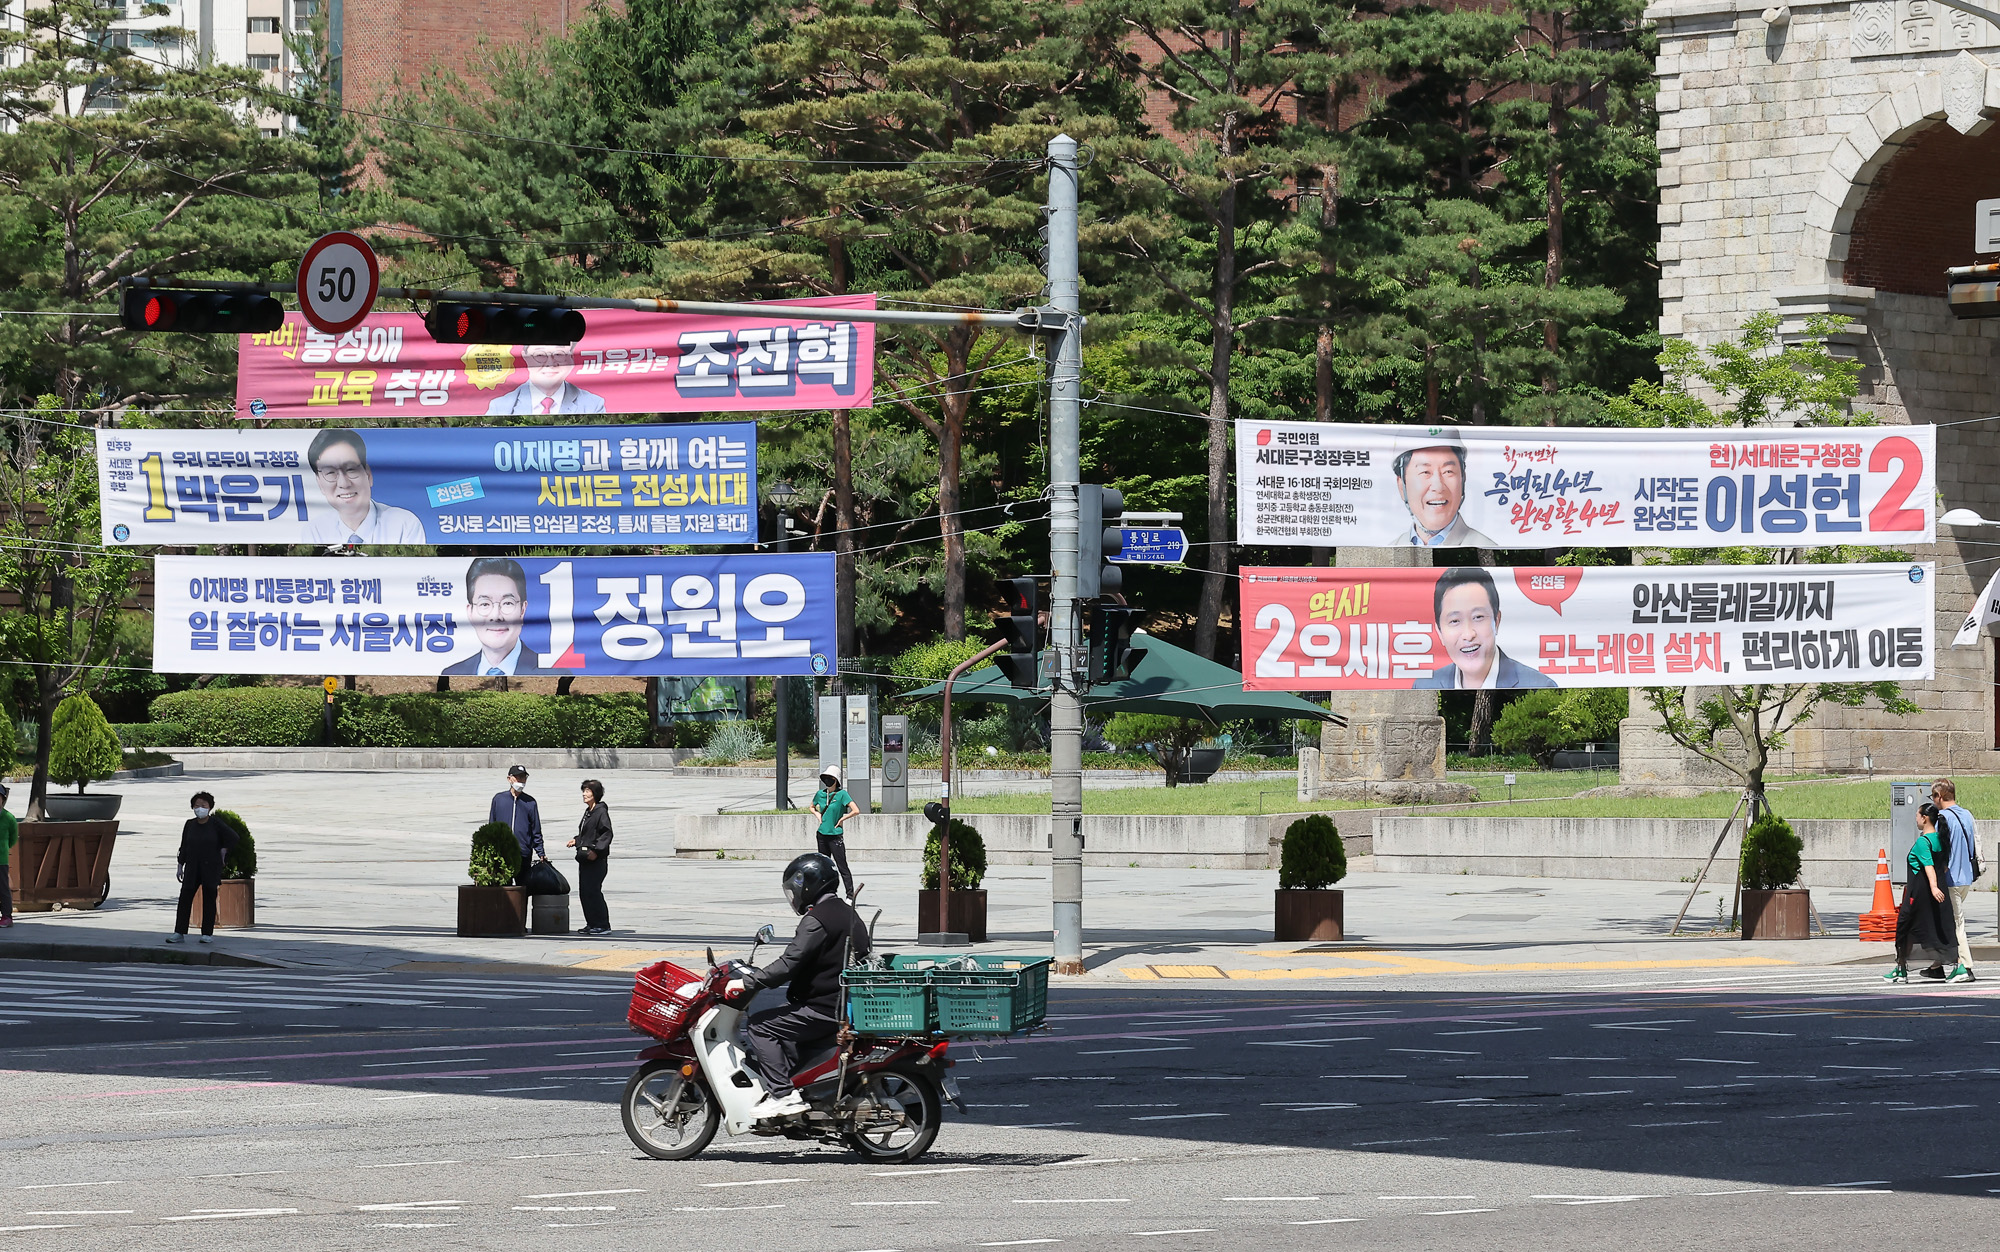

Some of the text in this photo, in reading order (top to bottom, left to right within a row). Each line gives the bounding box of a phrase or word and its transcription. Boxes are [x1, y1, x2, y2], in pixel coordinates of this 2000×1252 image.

[318, 266, 356, 303] 50
[301, 326, 403, 363] 동성애
[576, 322, 857, 397] 교육감은 조전혁
[307, 369, 456, 407] 교육 추방
[106, 440, 132, 452] 민주당
[1277, 432, 1320, 446] 국민의힘
[108, 458, 133, 469] 서대문
[172, 450, 300, 469] 우리 모두의 구청장
[494, 435, 748, 473] 이재명과 함께 여는
[1256, 449, 1371, 467] 서대문구청장후보
[1709, 443, 1863, 470] 현)서대문구청장
[109, 470, 134, 481] 구청장
[110, 481, 127, 492] 후보
[138, 451, 176, 523] 1
[1256, 476, 1373, 491] 서대문 16·18대 국회의원(전)
[1484, 468, 1602, 506] 증명된 4년
[1868, 435, 1925, 532] 2
[175, 474, 309, 523] 박운기
[436, 482, 475, 503] 천연동
[537, 472, 748, 508] 서대문 전성시대
[1256, 491, 1291, 501] 연세대학교
[1634, 477, 1699, 503] 시작도
[1705, 473, 1862, 534] 이성헌
[1256, 514, 1358, 526] 성균관대학교 대학원 언론학 박사
[1308, 503, 1354, 514] 총동문회장(전)
[1511, 497, 1625, 535] 완성할 4년
[1633, 506, 1698, 532] 완성도
[438, 513, 748, 535] 경사로 스마트 안심길 조성, 틈새 돌봄 지원 확대
[1129, 531, 1161, 544] 통일로
[1256, 526, 1333, 537] 한국애견협회 부회장(현)
[1167, 541, 1180, 550] 219
[189, 577, 382, 604] 이재명 대통령과 함께
[416, 582, 454, 597] 민주당
[1530, 575, 1566, 591] 천연동
[537, 561, 586, 669] 1
[1309, 582, 1371, 622] 역시!
[1632, 581, 1834, 624] 안산둘레길까지
[592, 572, 812, 661] 정원오
[189, 610, 458, 652] 일 잘하는 서울시장
[1255, 603, 1296, 678] 2
[1299, 620, 1434, 680] 오세훈
[1538, 627, 1923, 674] 모노레일 설치, 편리하게 이동
